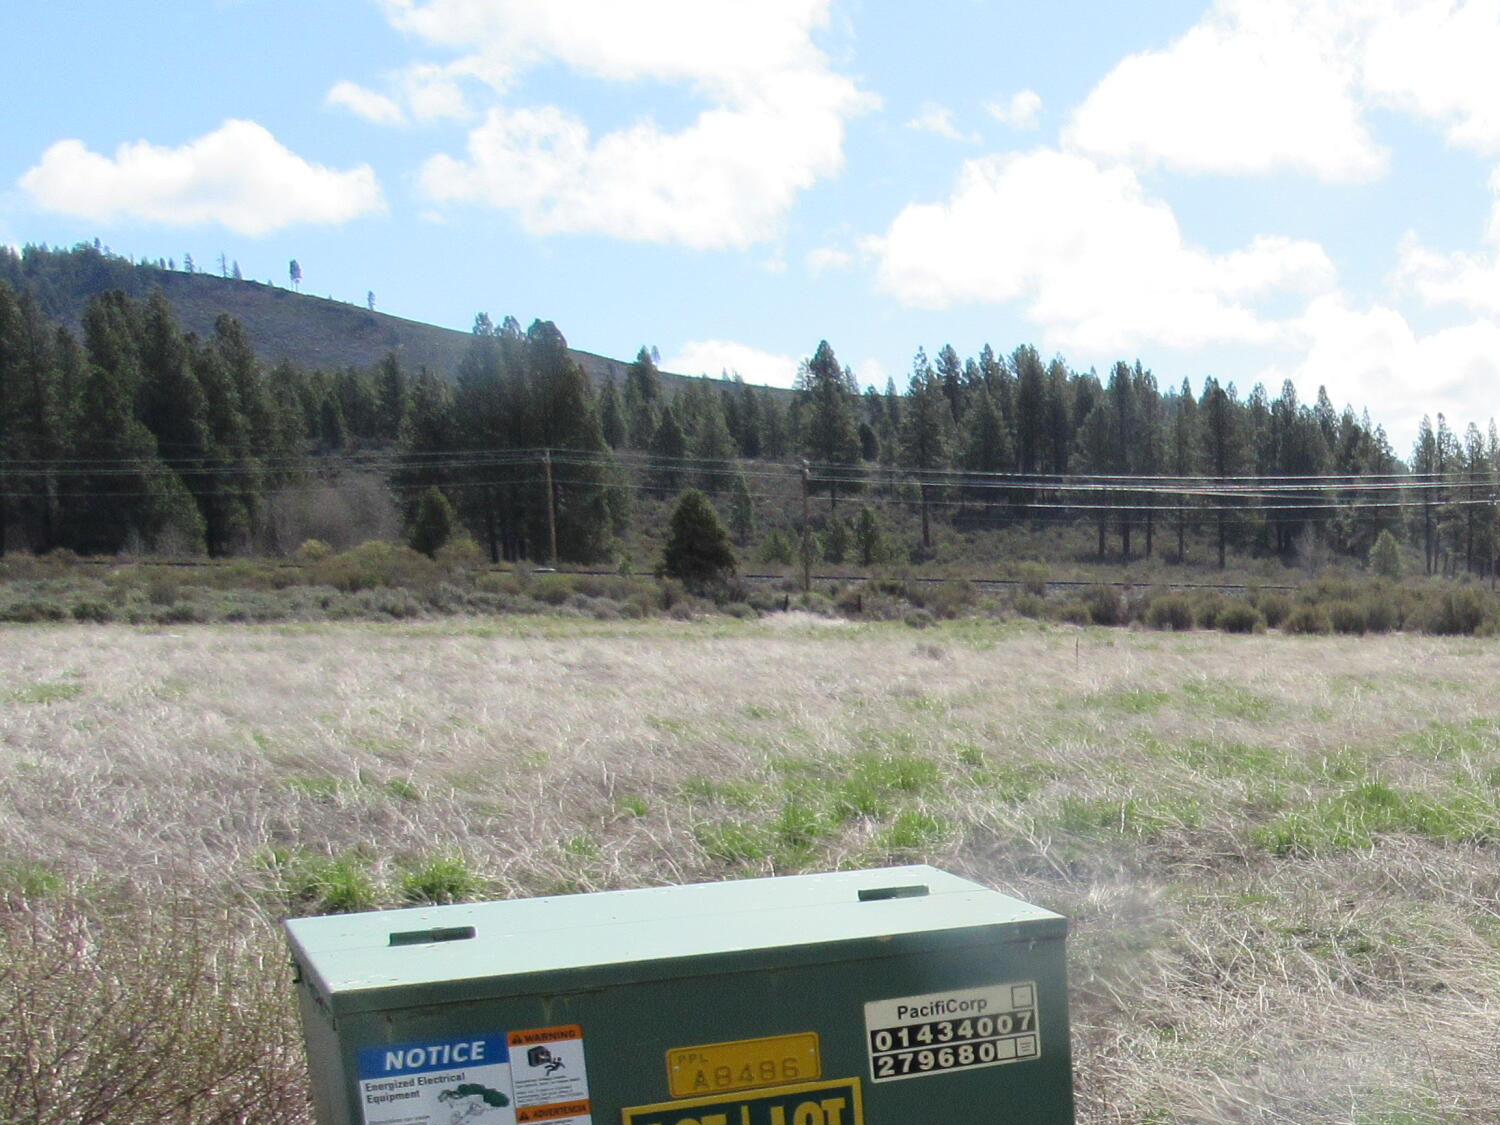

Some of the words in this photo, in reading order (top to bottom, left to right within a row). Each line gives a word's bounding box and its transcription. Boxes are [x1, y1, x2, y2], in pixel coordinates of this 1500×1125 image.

[897, 998, 987, 1019] PacifiCorp
[875, 1012, 1032, 1051] 01434007
[385, 1041, 486, 1071] NOTICE
[878, 1043, 995, 1077] 279680
[365, 1080, 415, 1092] Energized
[417, 1072, 465, 1086] Electrical
[366, 1090, 420, 1105] Equipment
